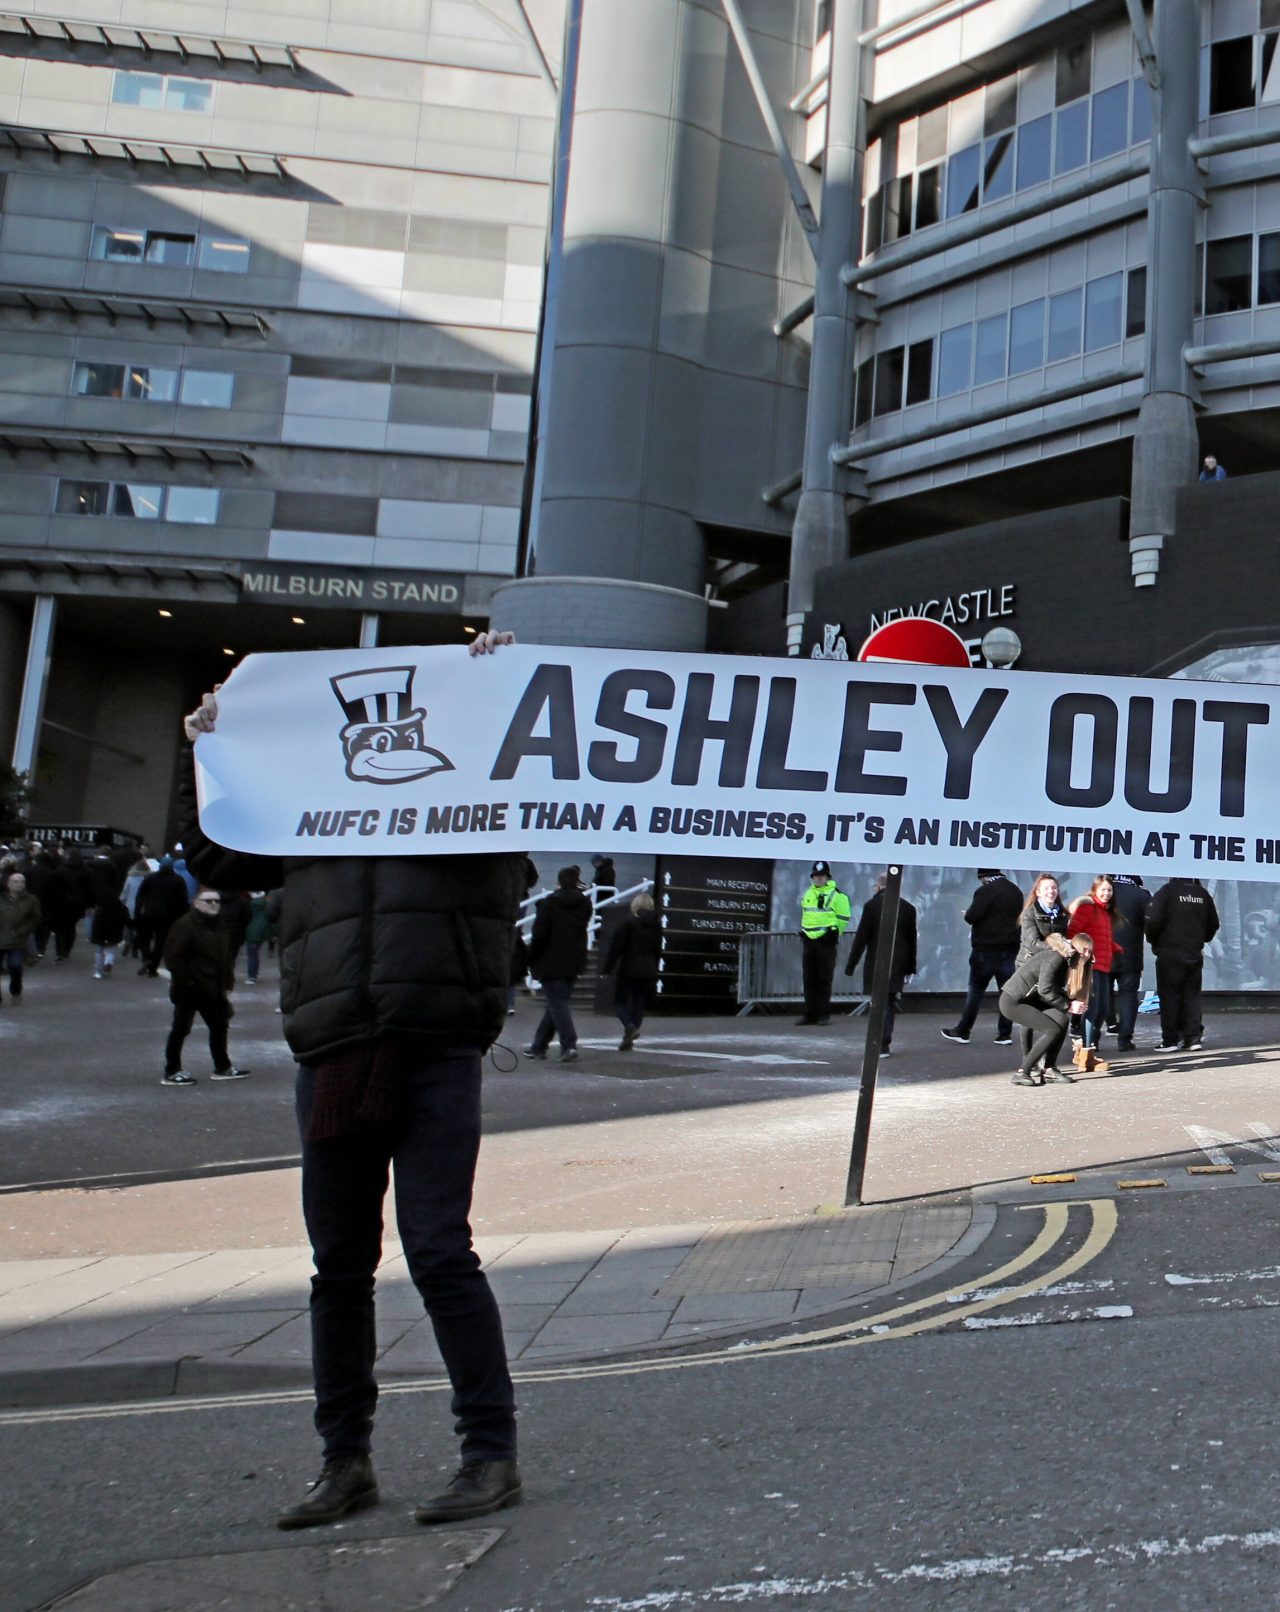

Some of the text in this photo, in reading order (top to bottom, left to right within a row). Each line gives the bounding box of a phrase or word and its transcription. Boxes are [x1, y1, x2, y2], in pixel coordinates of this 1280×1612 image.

[242, 573, 458, 603] MILBURN STAND
[489, 663, 1010, 800] ASHLEY
[1044, 692, 1271, 818] OUT
[61, 829, 98, 842] HUT
[295, 809, 380, 837] NUFC
[387, 807, 418, 836] IS
[424, 802, 509, 834] MORE
[518, 801, 605, 831] THAN
[612, 804, 638, 833] A
[648, 806, 815, 844] BUSINESS,
[825, 813, 885, 845] IT'S
[893, 817, 941, 846] AN
[949, 819, 1133, 857] INSTITUTION
[1141, 830, 1181, 858] AT
[1189, 833, 1246, 863] THE
[707, 878, 768, 892] MAIN RECEPTION
[708, 899, 767, 912] MILBURN STAND
[692, 918, 734, 930] TURNSTILES
[745, 922, 756, 932] TO
